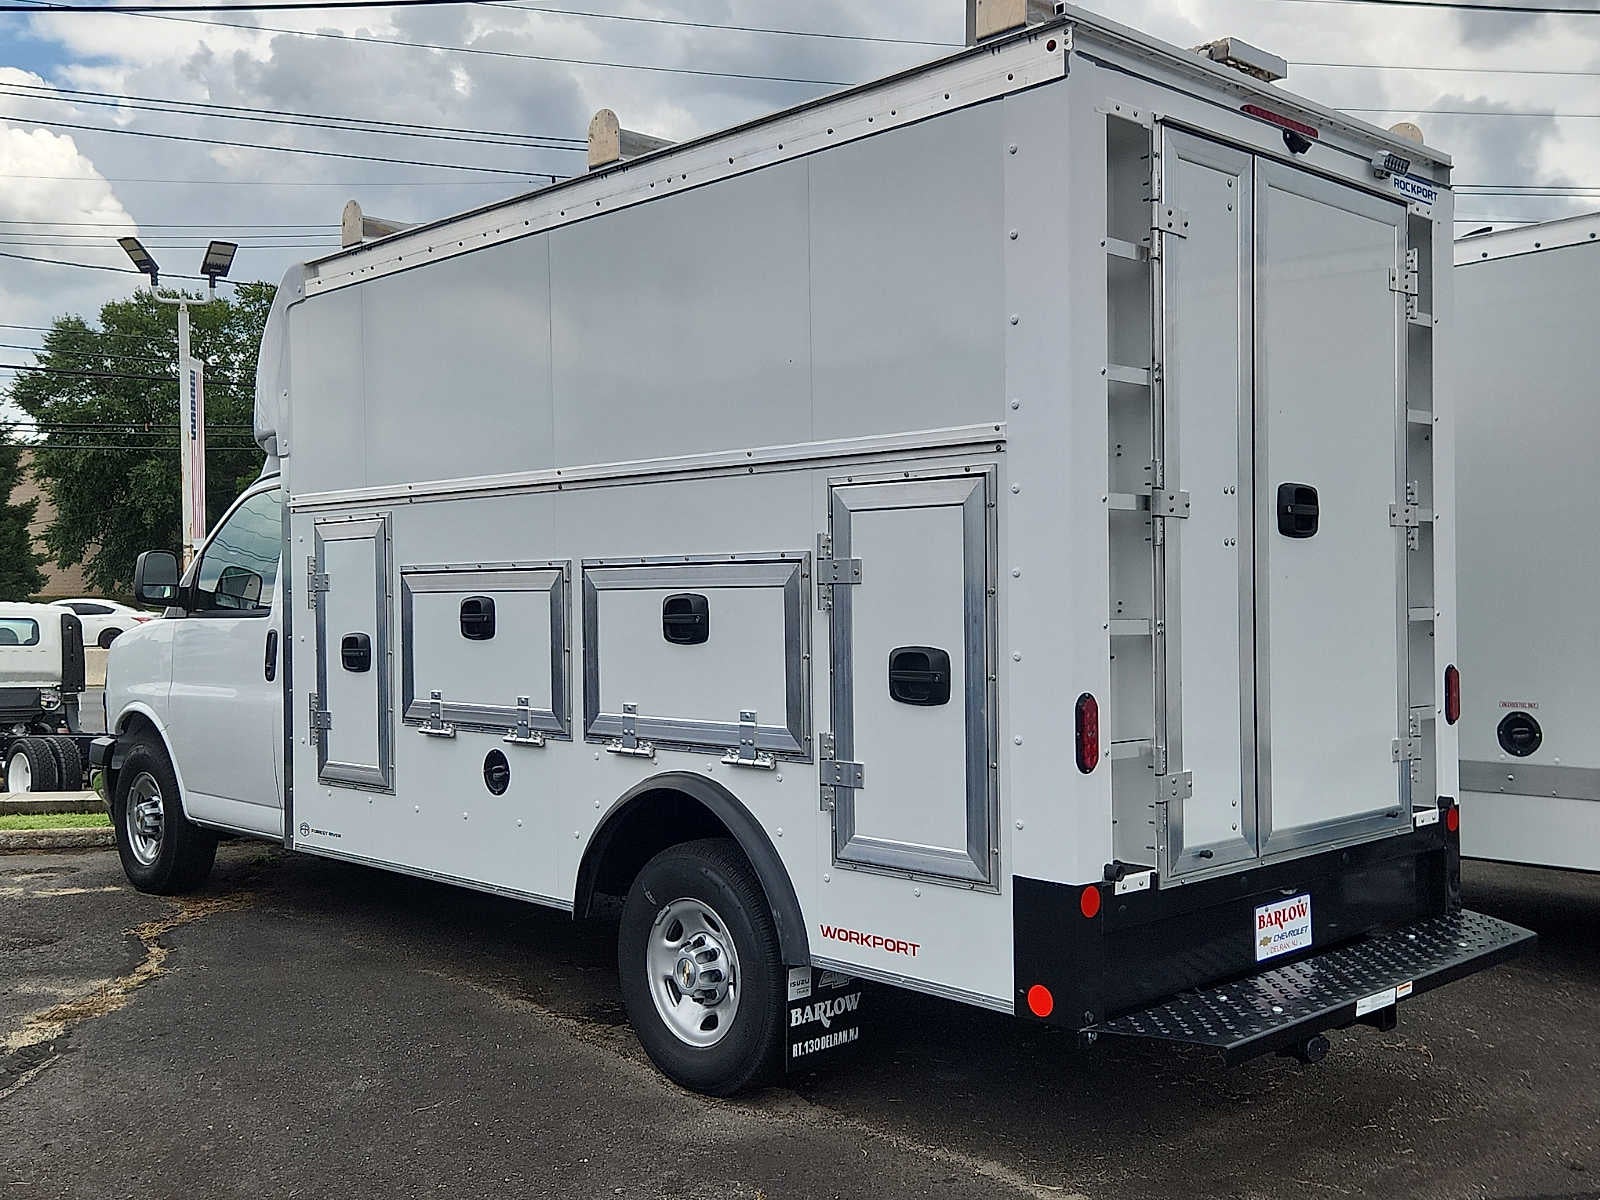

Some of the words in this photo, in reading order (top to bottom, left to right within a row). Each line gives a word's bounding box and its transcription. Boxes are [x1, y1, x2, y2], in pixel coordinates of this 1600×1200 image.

[1393, 177, 1438, 202] ROCKPORT
[1258, 902, 1308, 930] BARLOW
[820, 924, 920, 957] WORKPORT
[1273, 925, 1308, 943] CHEVROLET
[790, 992, 862, 1028] BARLOW
